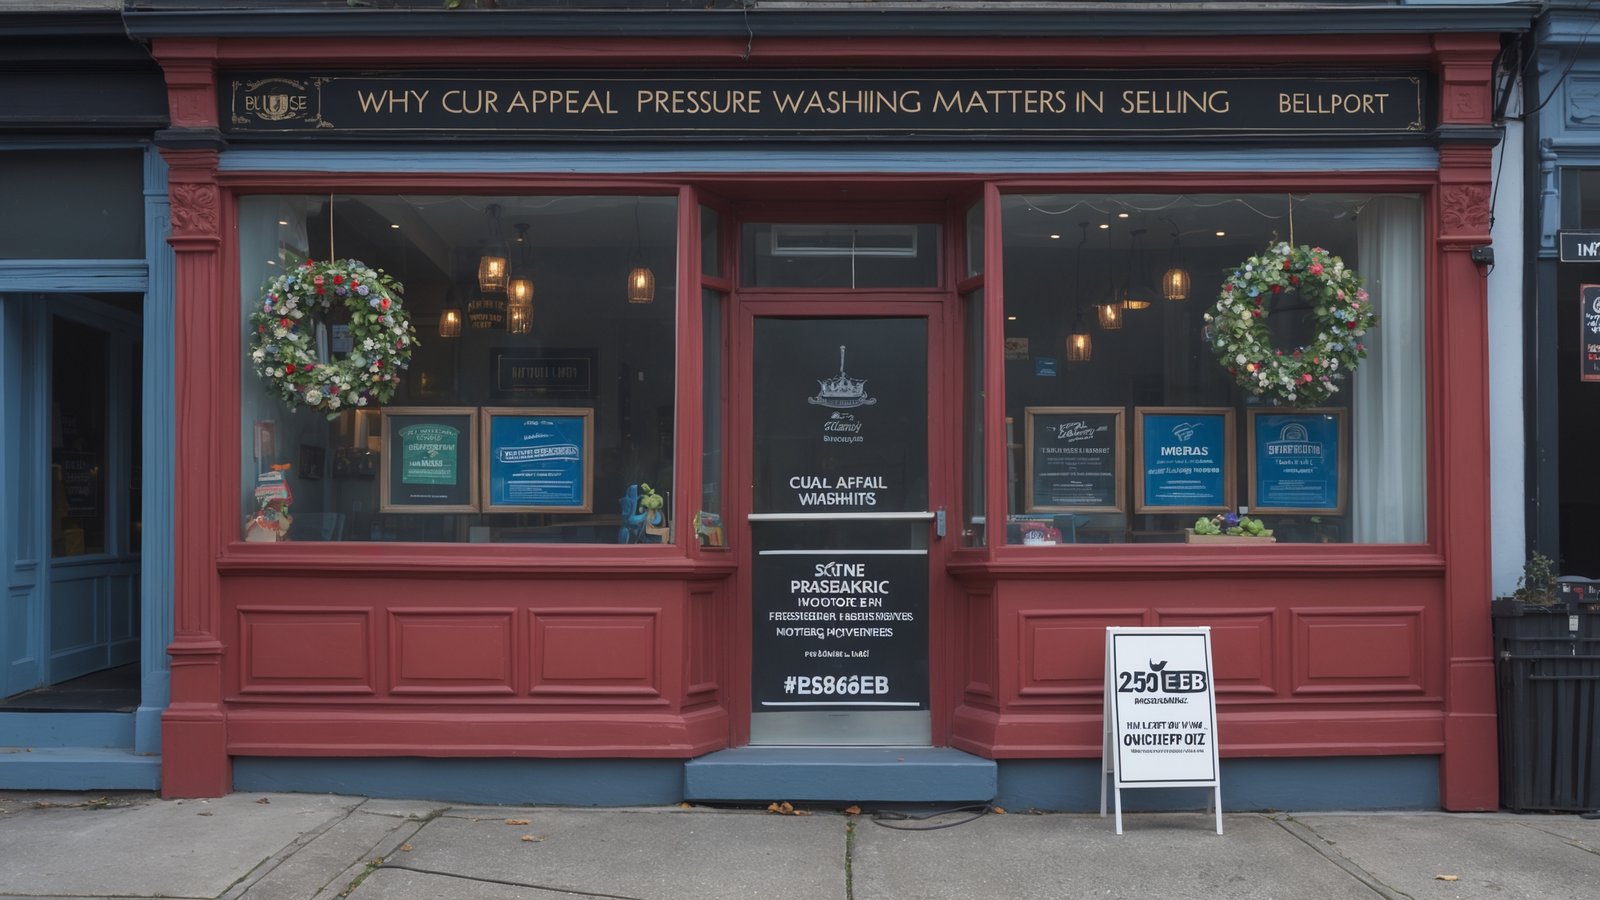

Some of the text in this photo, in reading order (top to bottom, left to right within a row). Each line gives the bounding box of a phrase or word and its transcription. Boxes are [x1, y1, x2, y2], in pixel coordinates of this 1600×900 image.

[357, 90, 430, 113] WHY
[442, 90, 499, 114] CUR
[506, 90, 618, 114] APPEAL
[637, 90, 762, 114] PRESSURE
[932, 90, 1066, 114] MATTERS
[1076, 90, 1104, 114] IN
[1120, 90, 1230, 114] SELLING
[1279, 93, 1390, 114] BELLPORT
[789, 476, 832, 489] CUAL
